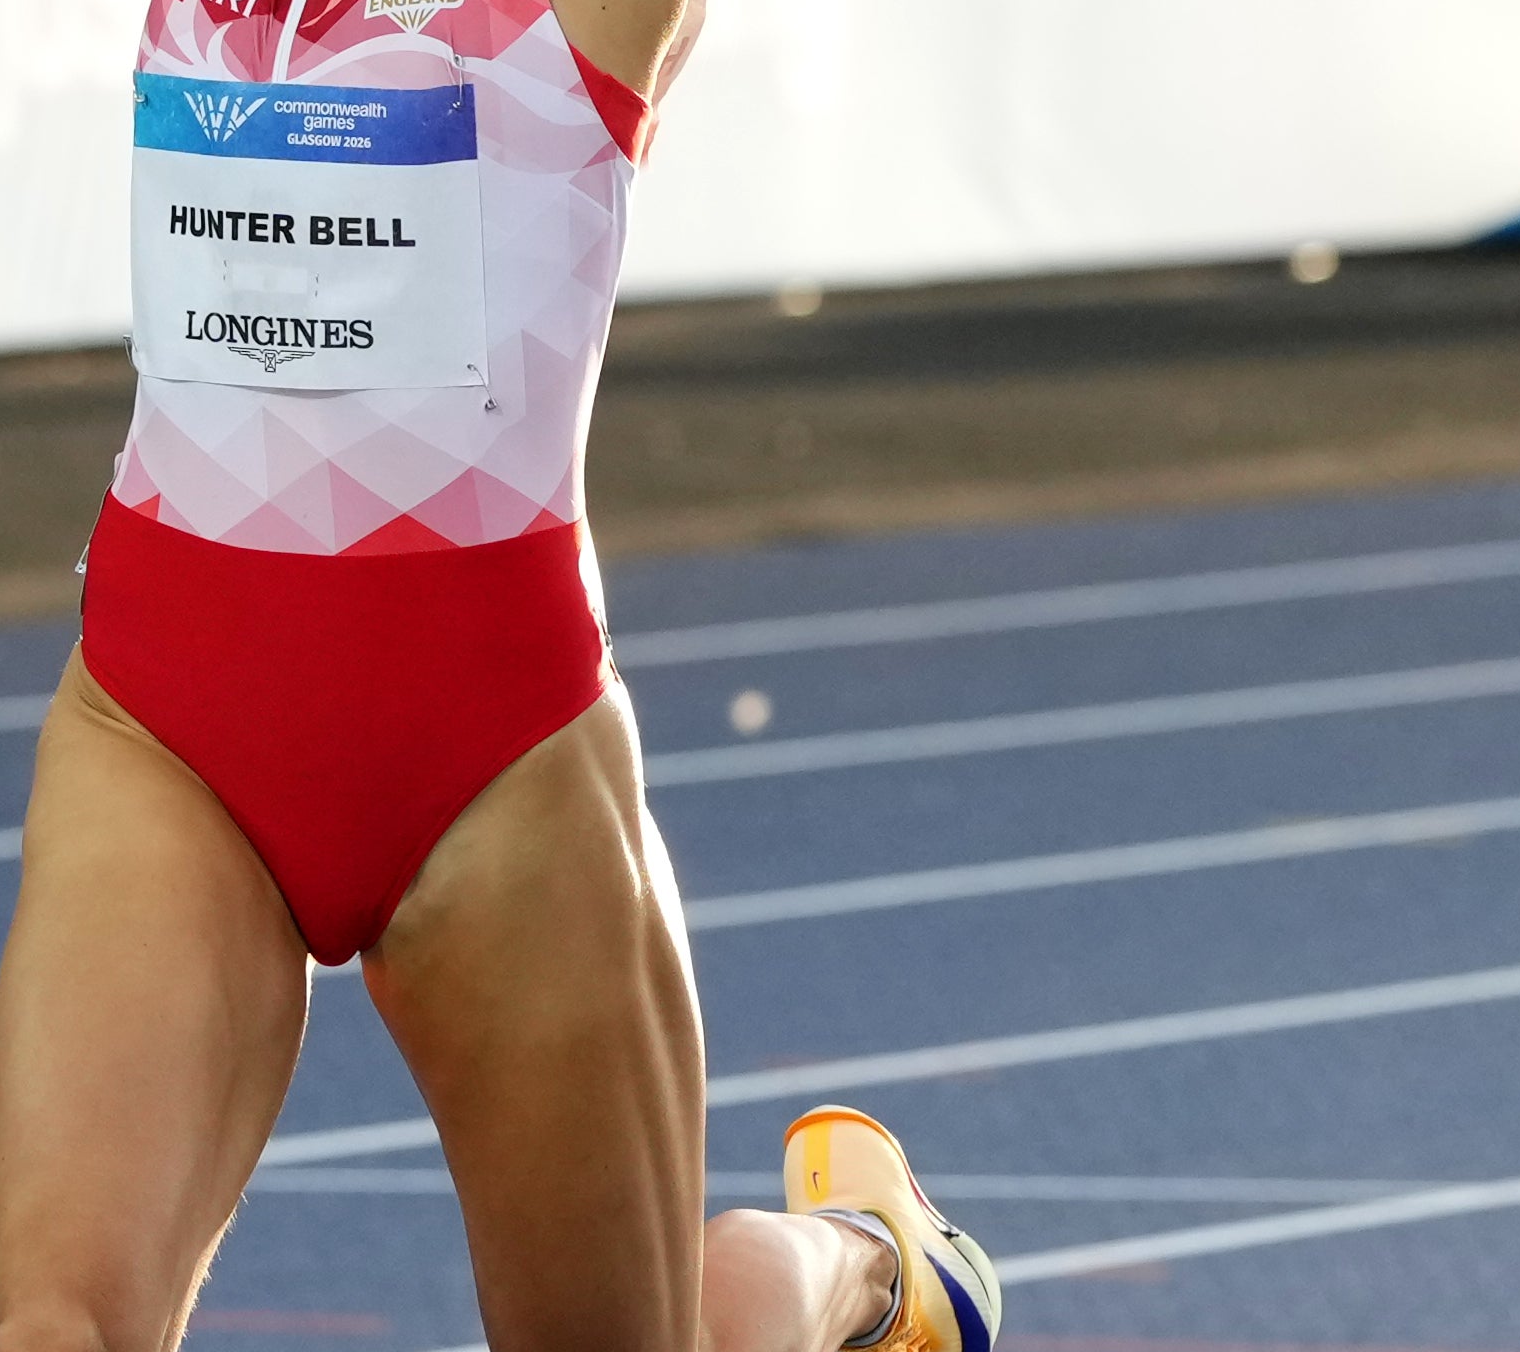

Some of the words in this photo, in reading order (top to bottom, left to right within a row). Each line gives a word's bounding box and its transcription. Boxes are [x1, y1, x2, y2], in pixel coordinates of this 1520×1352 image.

[273, 100, 387, 118] commonwealth
[303, 115, 356, 132] games
[287, 133, 342, 147] GLASGOW
[343, 136, 372, 148] 2026
[169, 204, 296, 244] HUNTER
[310, 215, 416, 247] BELL
[185, 310, 374, 349] LONGINES
